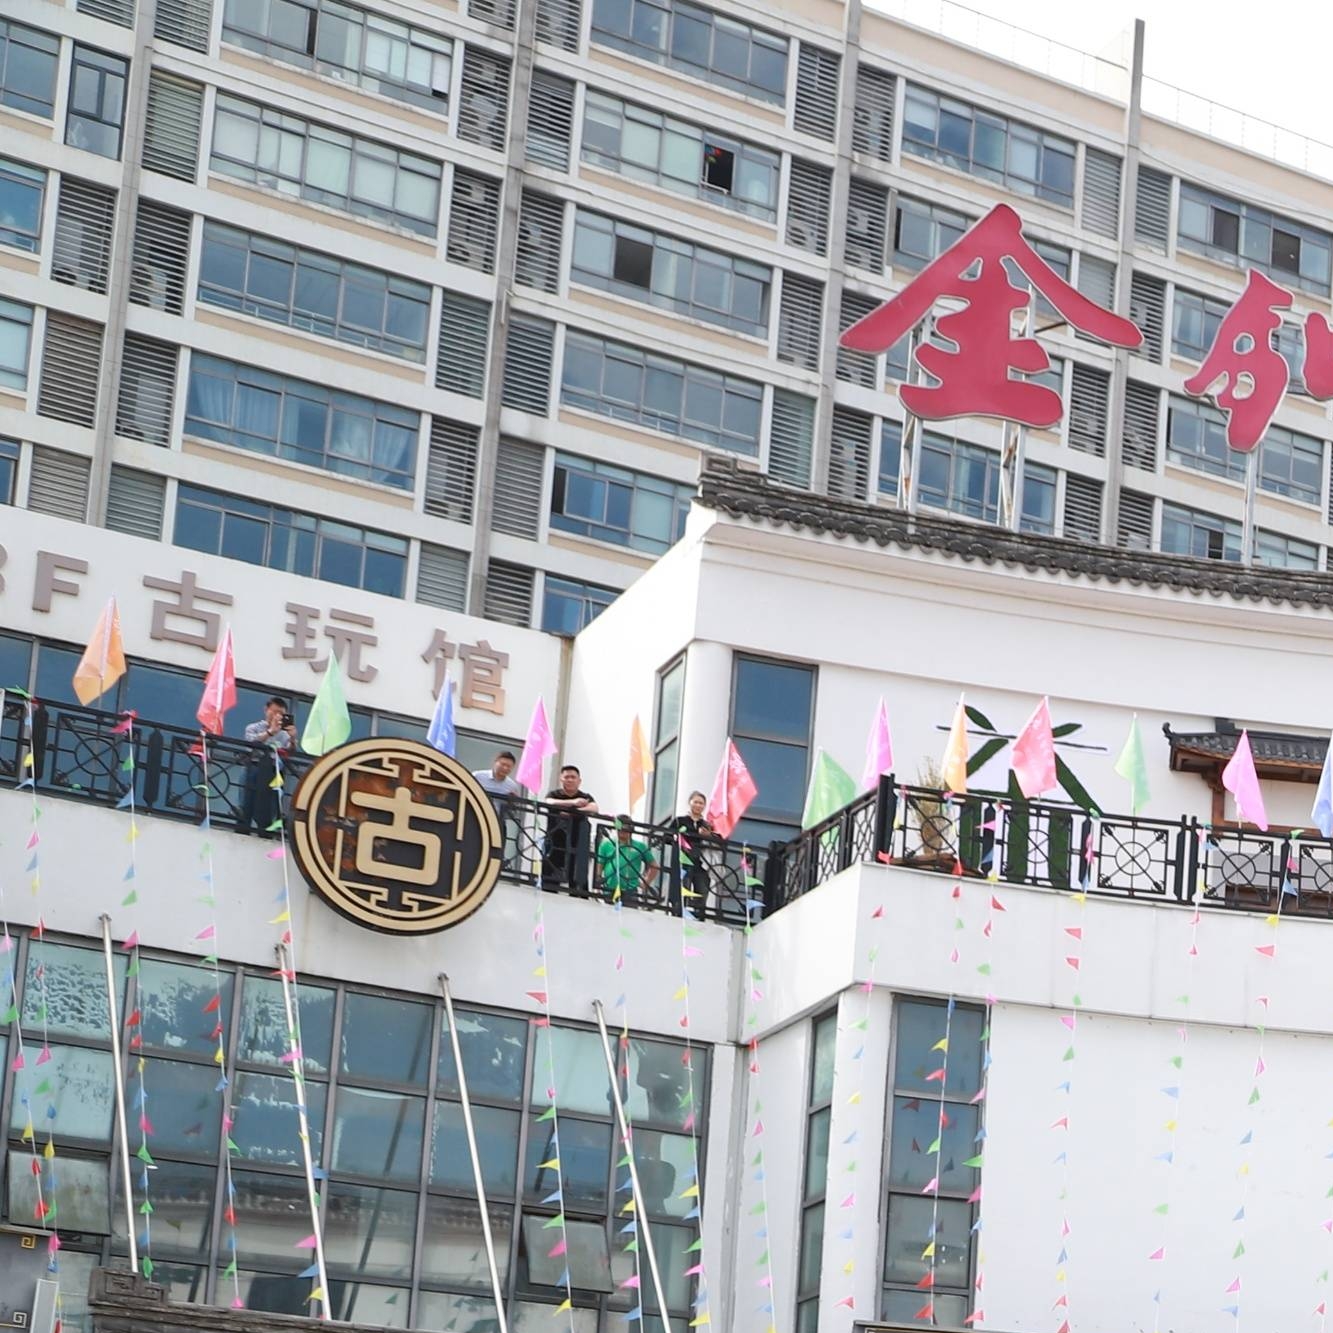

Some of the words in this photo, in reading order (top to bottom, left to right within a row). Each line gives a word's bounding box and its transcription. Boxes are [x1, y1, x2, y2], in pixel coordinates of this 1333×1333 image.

[0, 545, 89, 612] F
[143, 570, 509, 715] 古玩馆
[349, 786, 454, 887] 古
